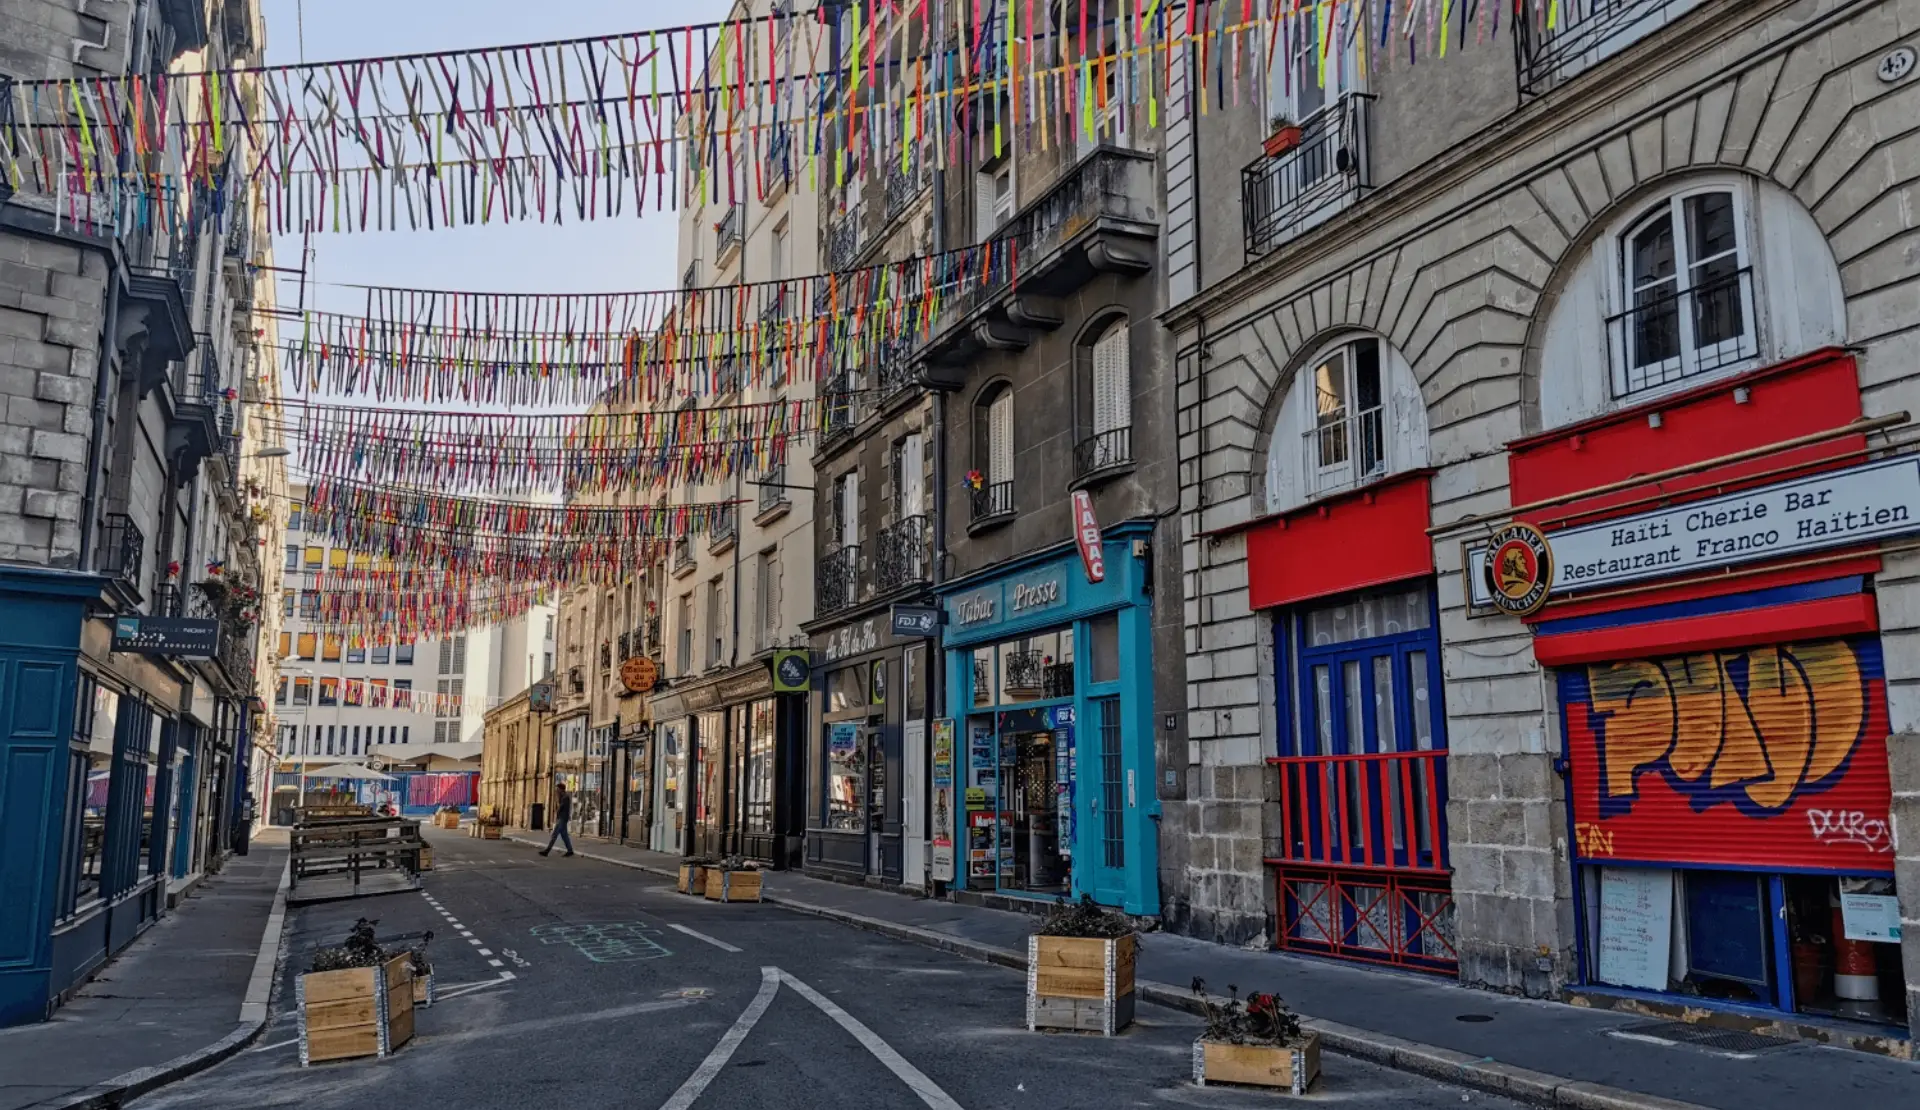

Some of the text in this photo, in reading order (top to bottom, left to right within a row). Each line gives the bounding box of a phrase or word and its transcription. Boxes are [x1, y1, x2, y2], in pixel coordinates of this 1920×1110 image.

[1077, 494, 1104, 577] TABAC
[1562, 503, 1909, 582] Restaurant Franco Haïtien
[1610, 486, 1832, 547] Haïti Chérie Bar
[1485, 526, 1545, 567] PAULANER
[899, 617, 916, 626] FDJ
[958, 580, 1057, 625] Tabac Presse
